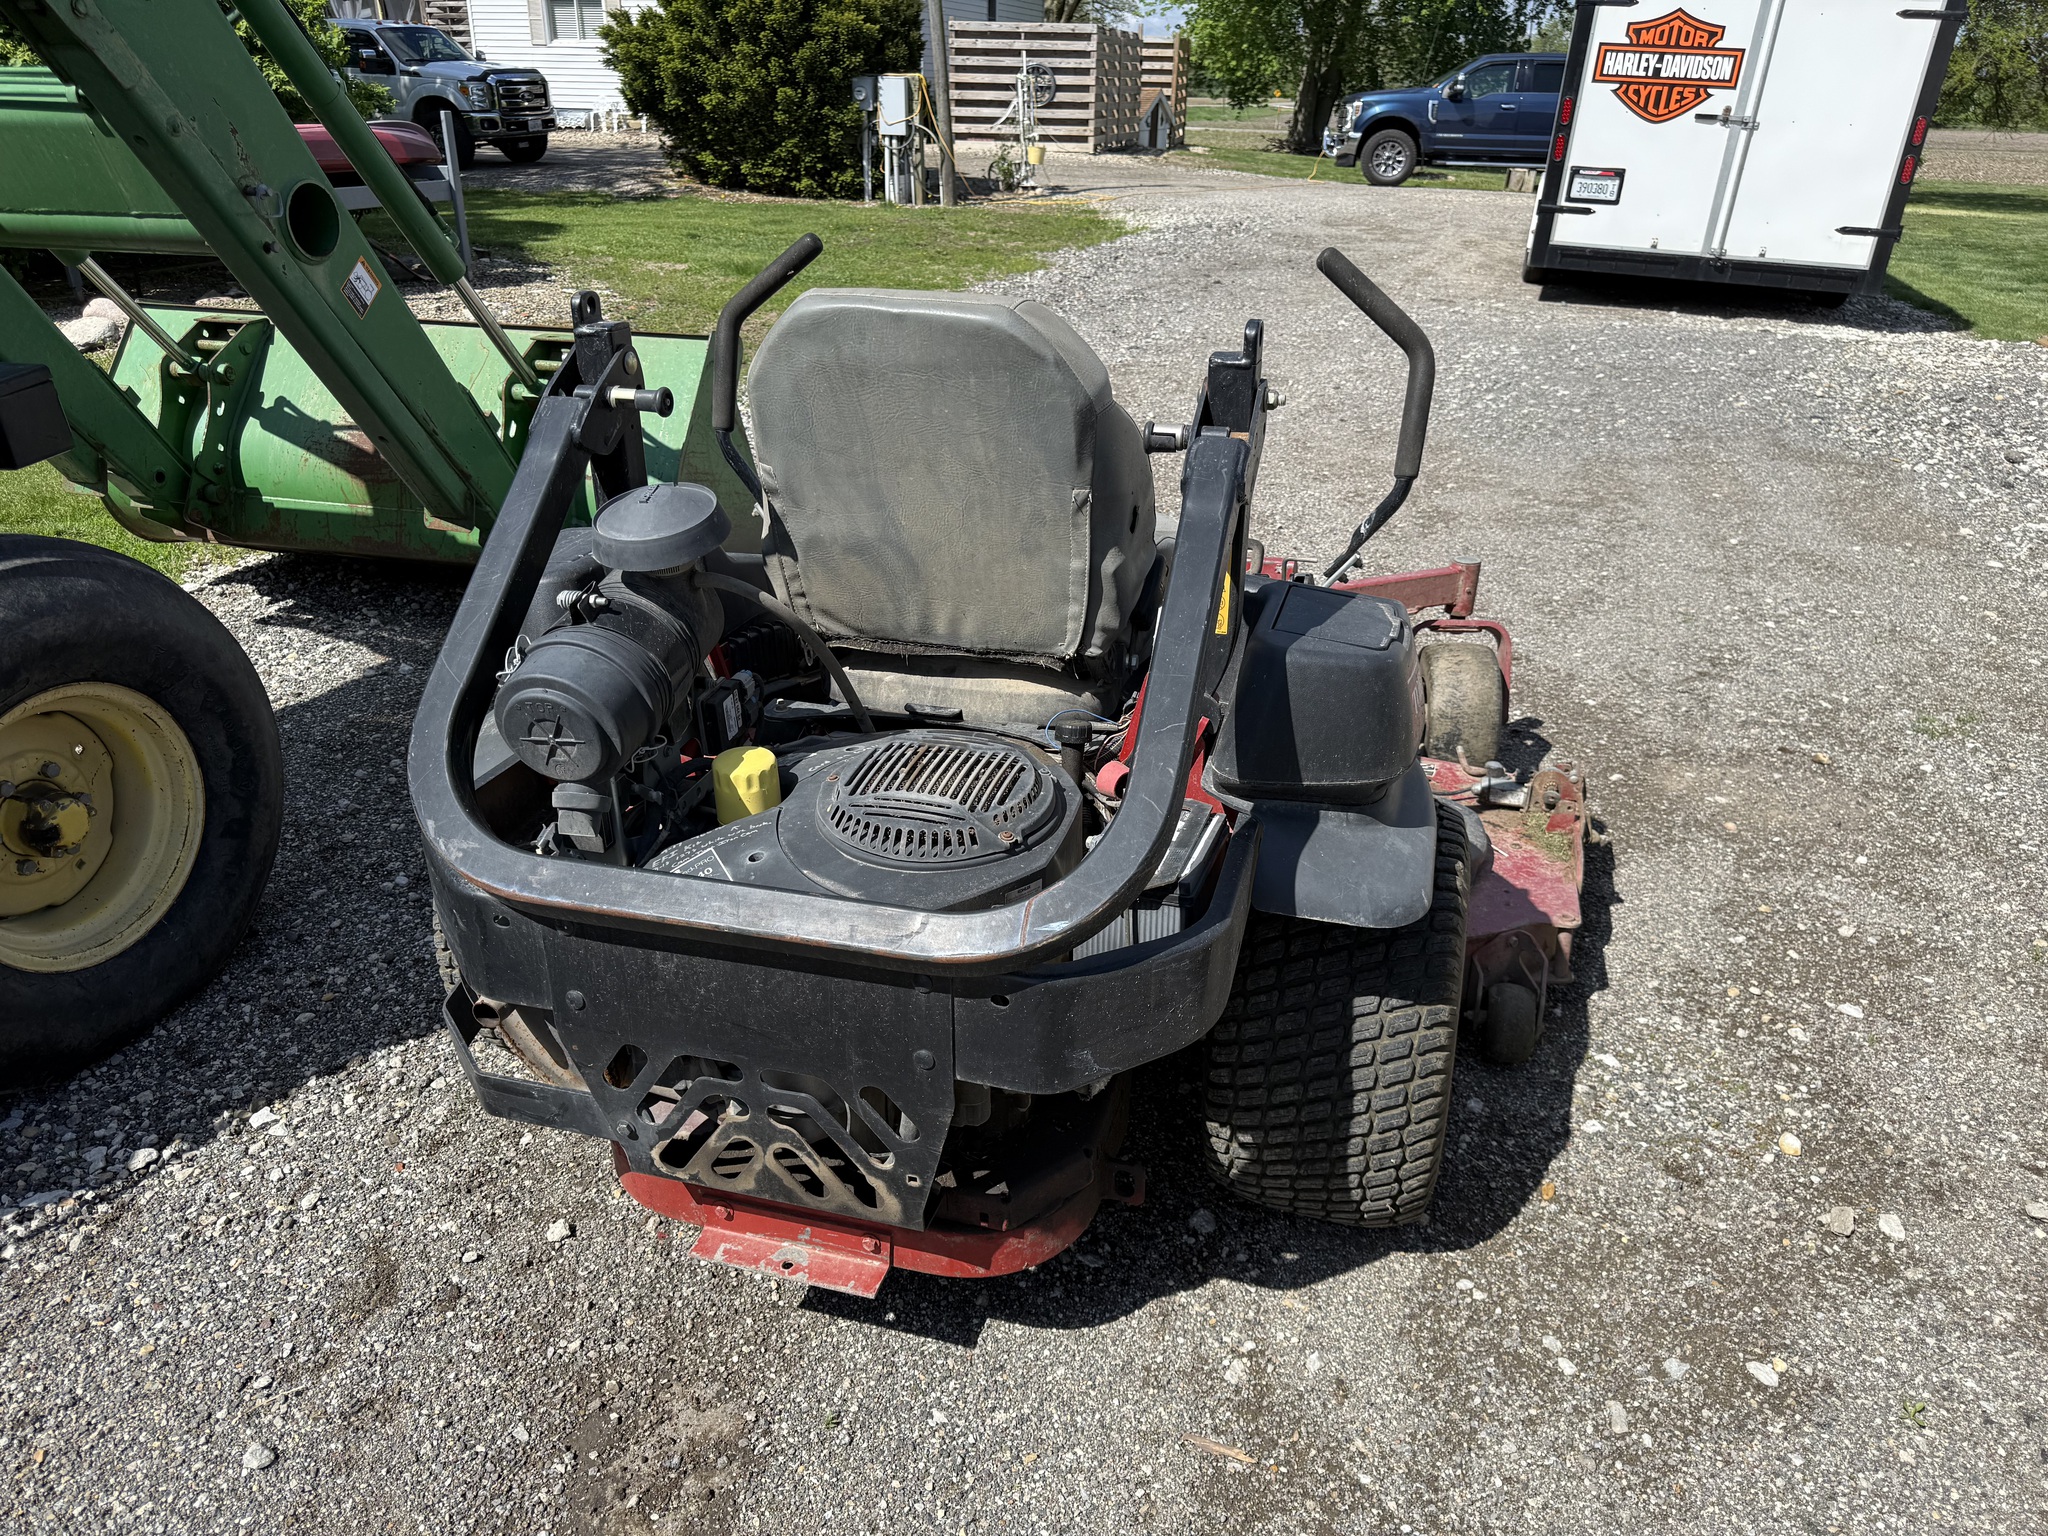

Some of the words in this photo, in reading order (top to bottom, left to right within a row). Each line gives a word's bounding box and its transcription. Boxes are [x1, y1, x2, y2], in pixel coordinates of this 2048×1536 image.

[1639, 19, 1709, 47] MOTOR
[1603, 51, 1735, 81] HARLEY-DAVIDSON
[1627, 84, 1697, 116] CYCLES
[1576, 182, 1609, 195] 390380
[524, 701, 553, 714] TOP
